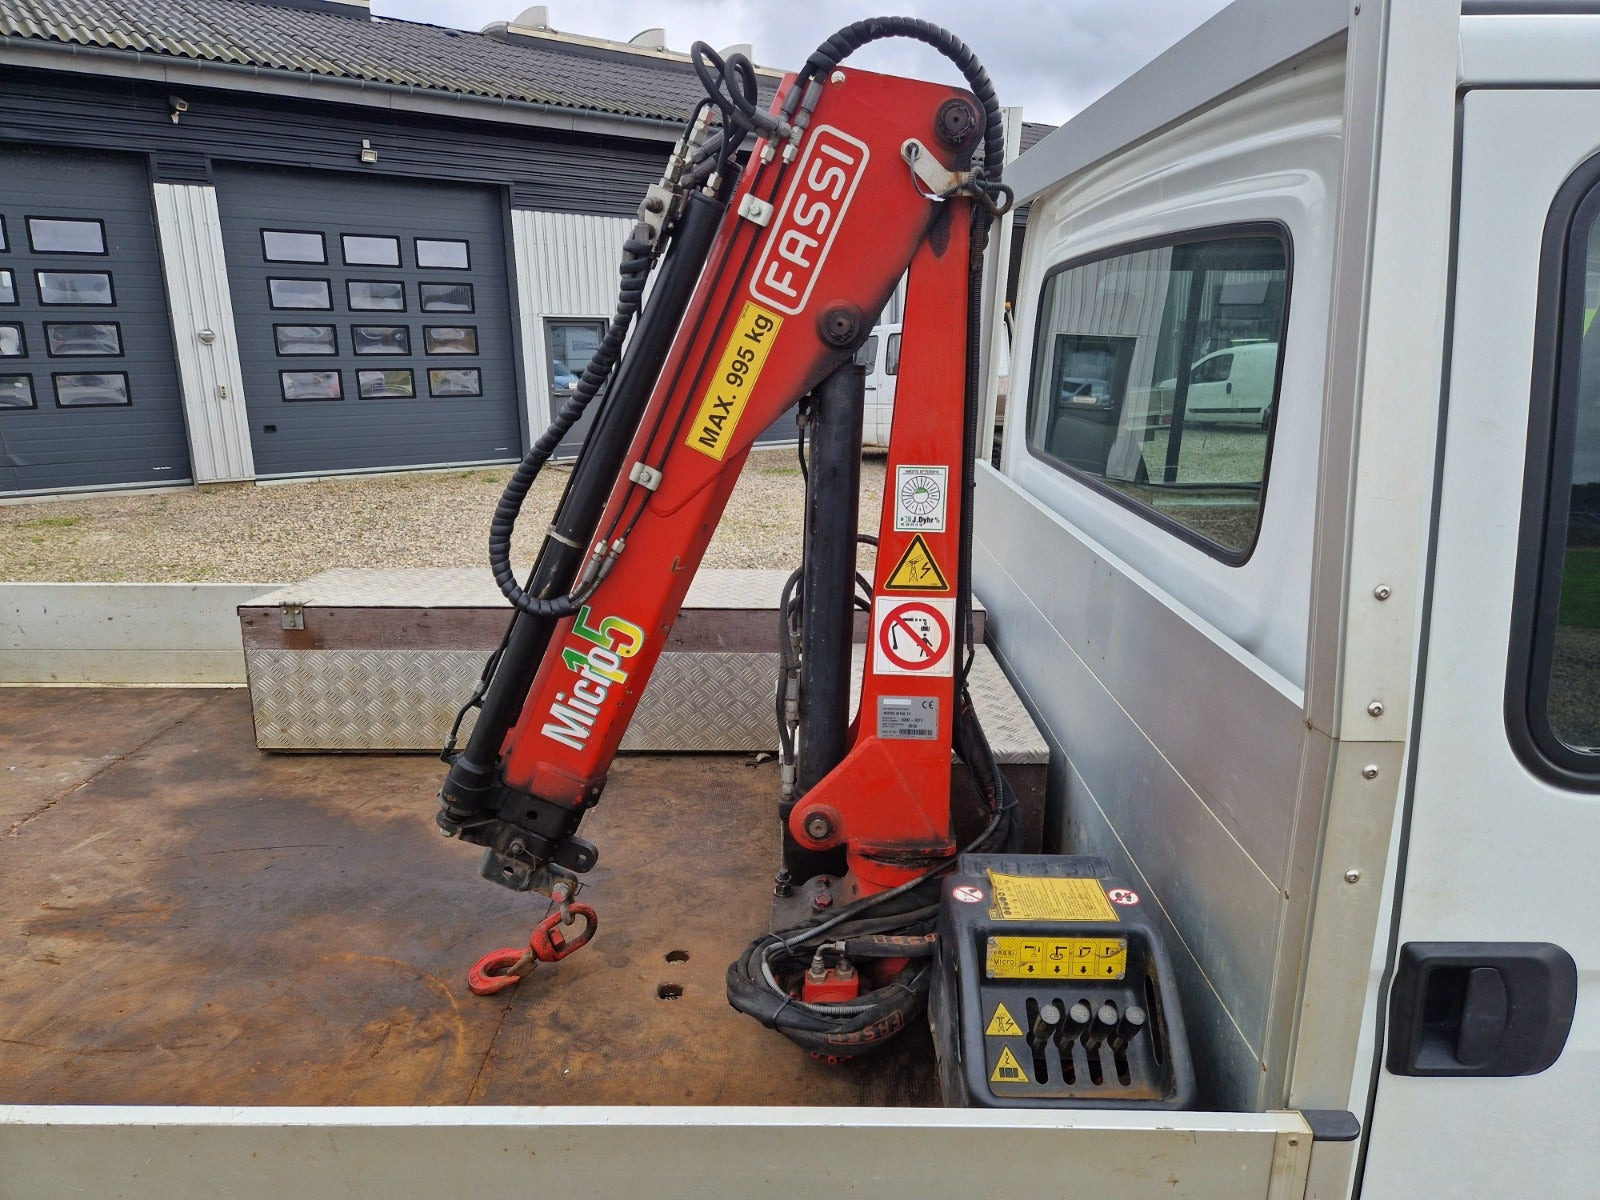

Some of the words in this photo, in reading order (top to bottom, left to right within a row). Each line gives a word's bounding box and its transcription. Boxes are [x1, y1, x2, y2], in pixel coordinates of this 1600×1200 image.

[764, 143, 855, 298] FASSI
[698, 394, 737, 448] MAX.
[726, 346, 755, 388] 995
[745, 313, 774, 343] kg
[540, 646, 621, 751] Micro
[994, 957, 1015, 966] Micro
